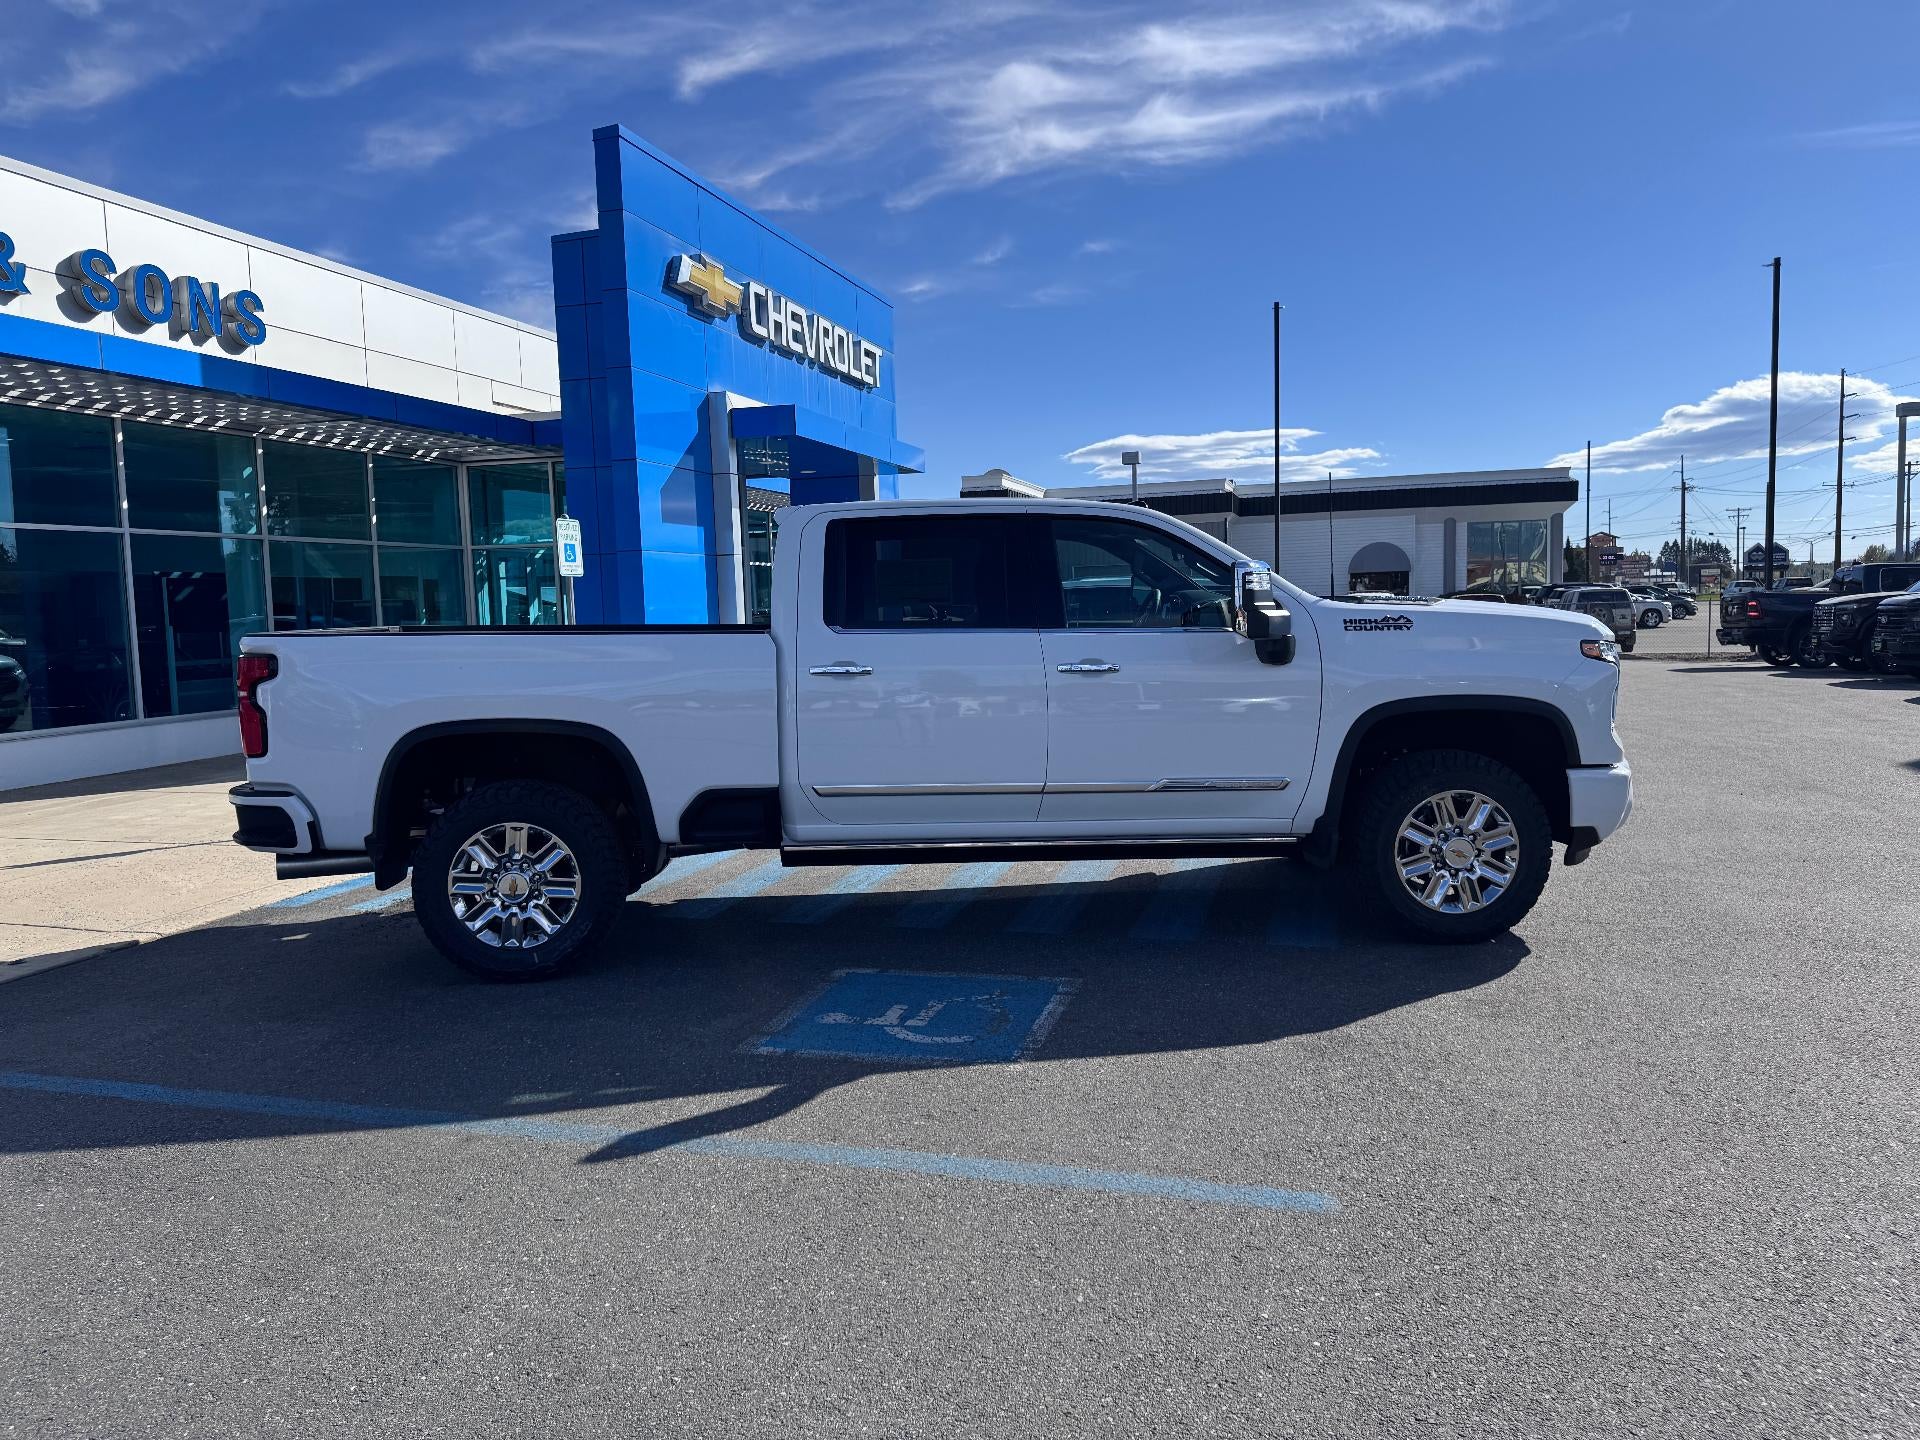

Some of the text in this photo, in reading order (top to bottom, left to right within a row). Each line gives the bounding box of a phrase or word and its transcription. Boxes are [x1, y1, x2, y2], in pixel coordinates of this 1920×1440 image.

[74, 249, 267, 346] SONS
[746, 281, 883, 388] CHEVROLET
[1343, 618, 1380, 626] HIGH
